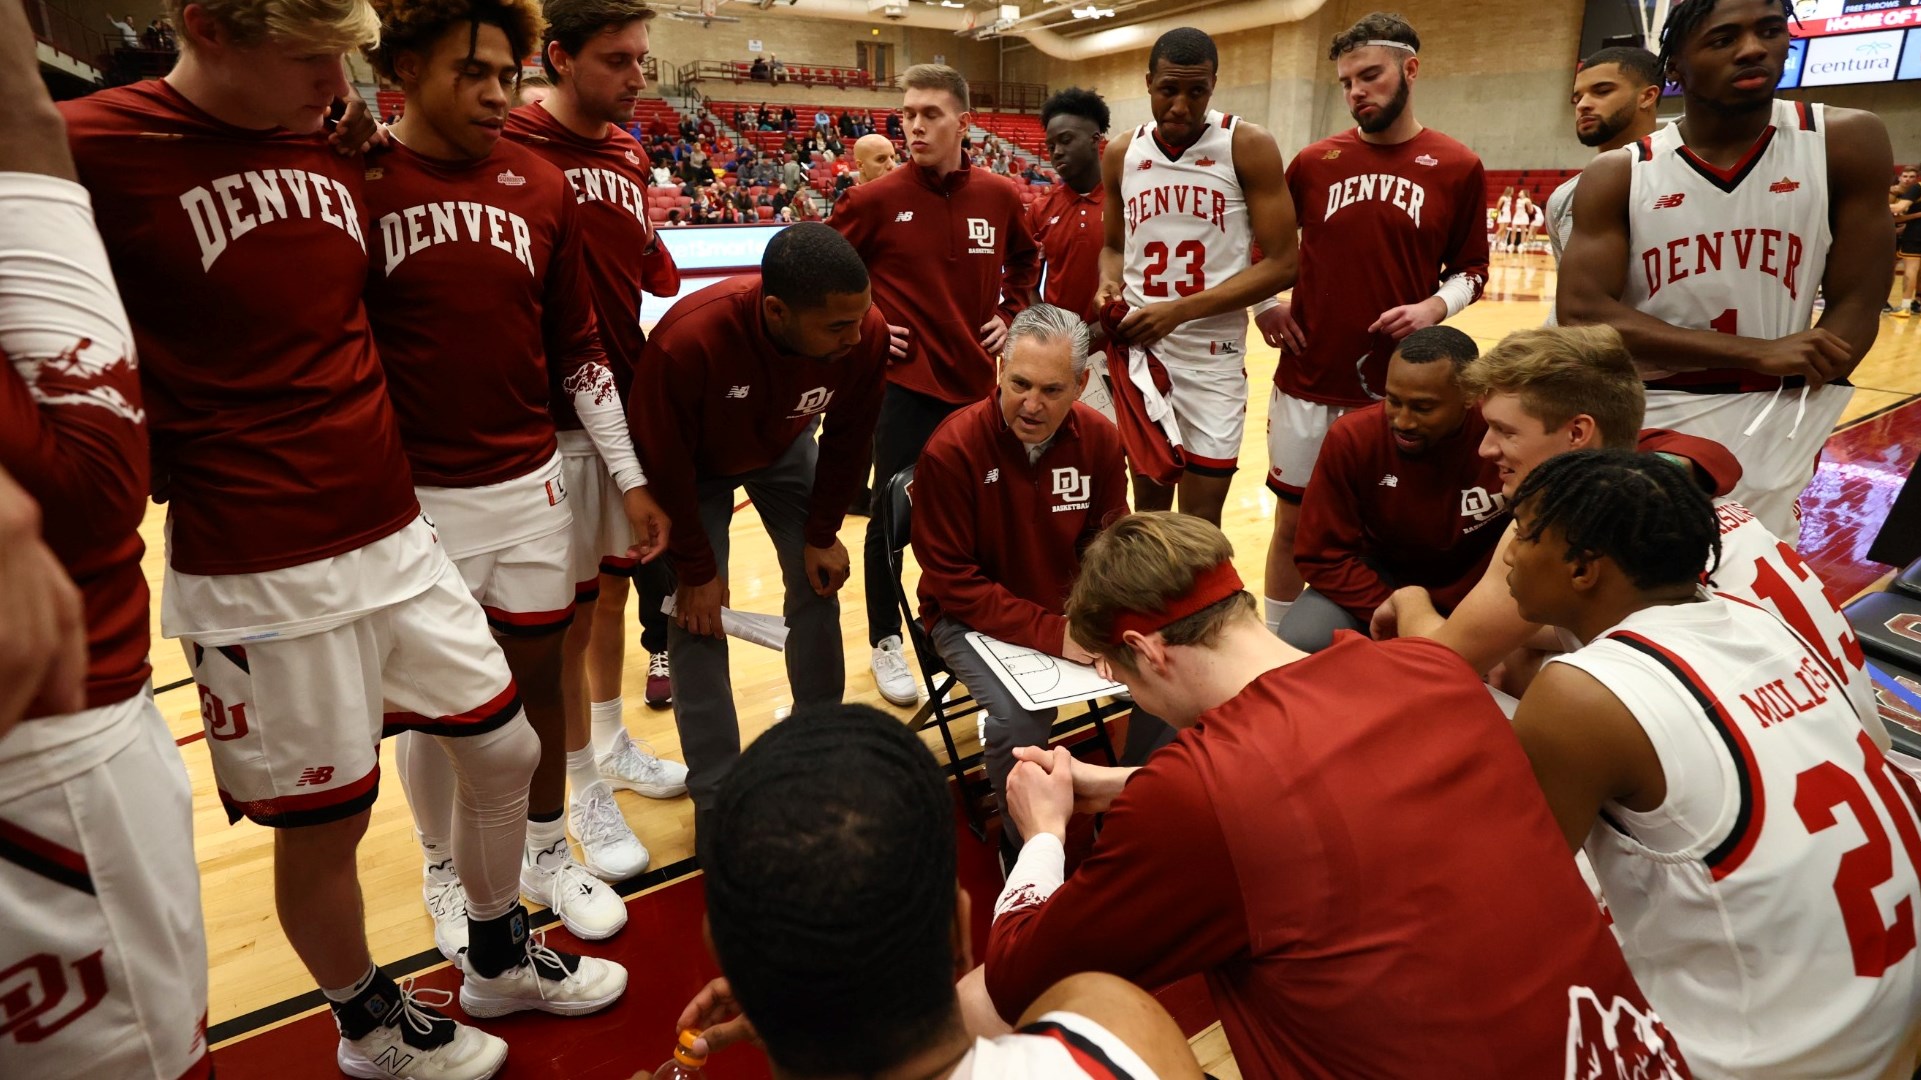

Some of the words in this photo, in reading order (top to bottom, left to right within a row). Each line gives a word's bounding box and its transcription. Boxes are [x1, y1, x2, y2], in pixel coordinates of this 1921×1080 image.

[1825, 13, 1883, 32] HOME
[1884, 9, 1912, 24] OF
[1845, 4, 1865, 13] FREE
[1865, 1, 1900, 10] THROWS
[1810, 57, 1889, 74] centura
[179, 169, 367, 273] DENVER
[564, 168, 647, 234] ENVER
[1128, 185, 1226, 236] DENVER
[1324, 173, 1425, 229] DENVER
[379, 201, 535, 278] DENVER
[1642, 228, 1803, 301] DENVER
[1143, 240, 1206, 297] 23
[1051, 467, 1091, 502] DU
[1750, 541, 1865, 686] 13
